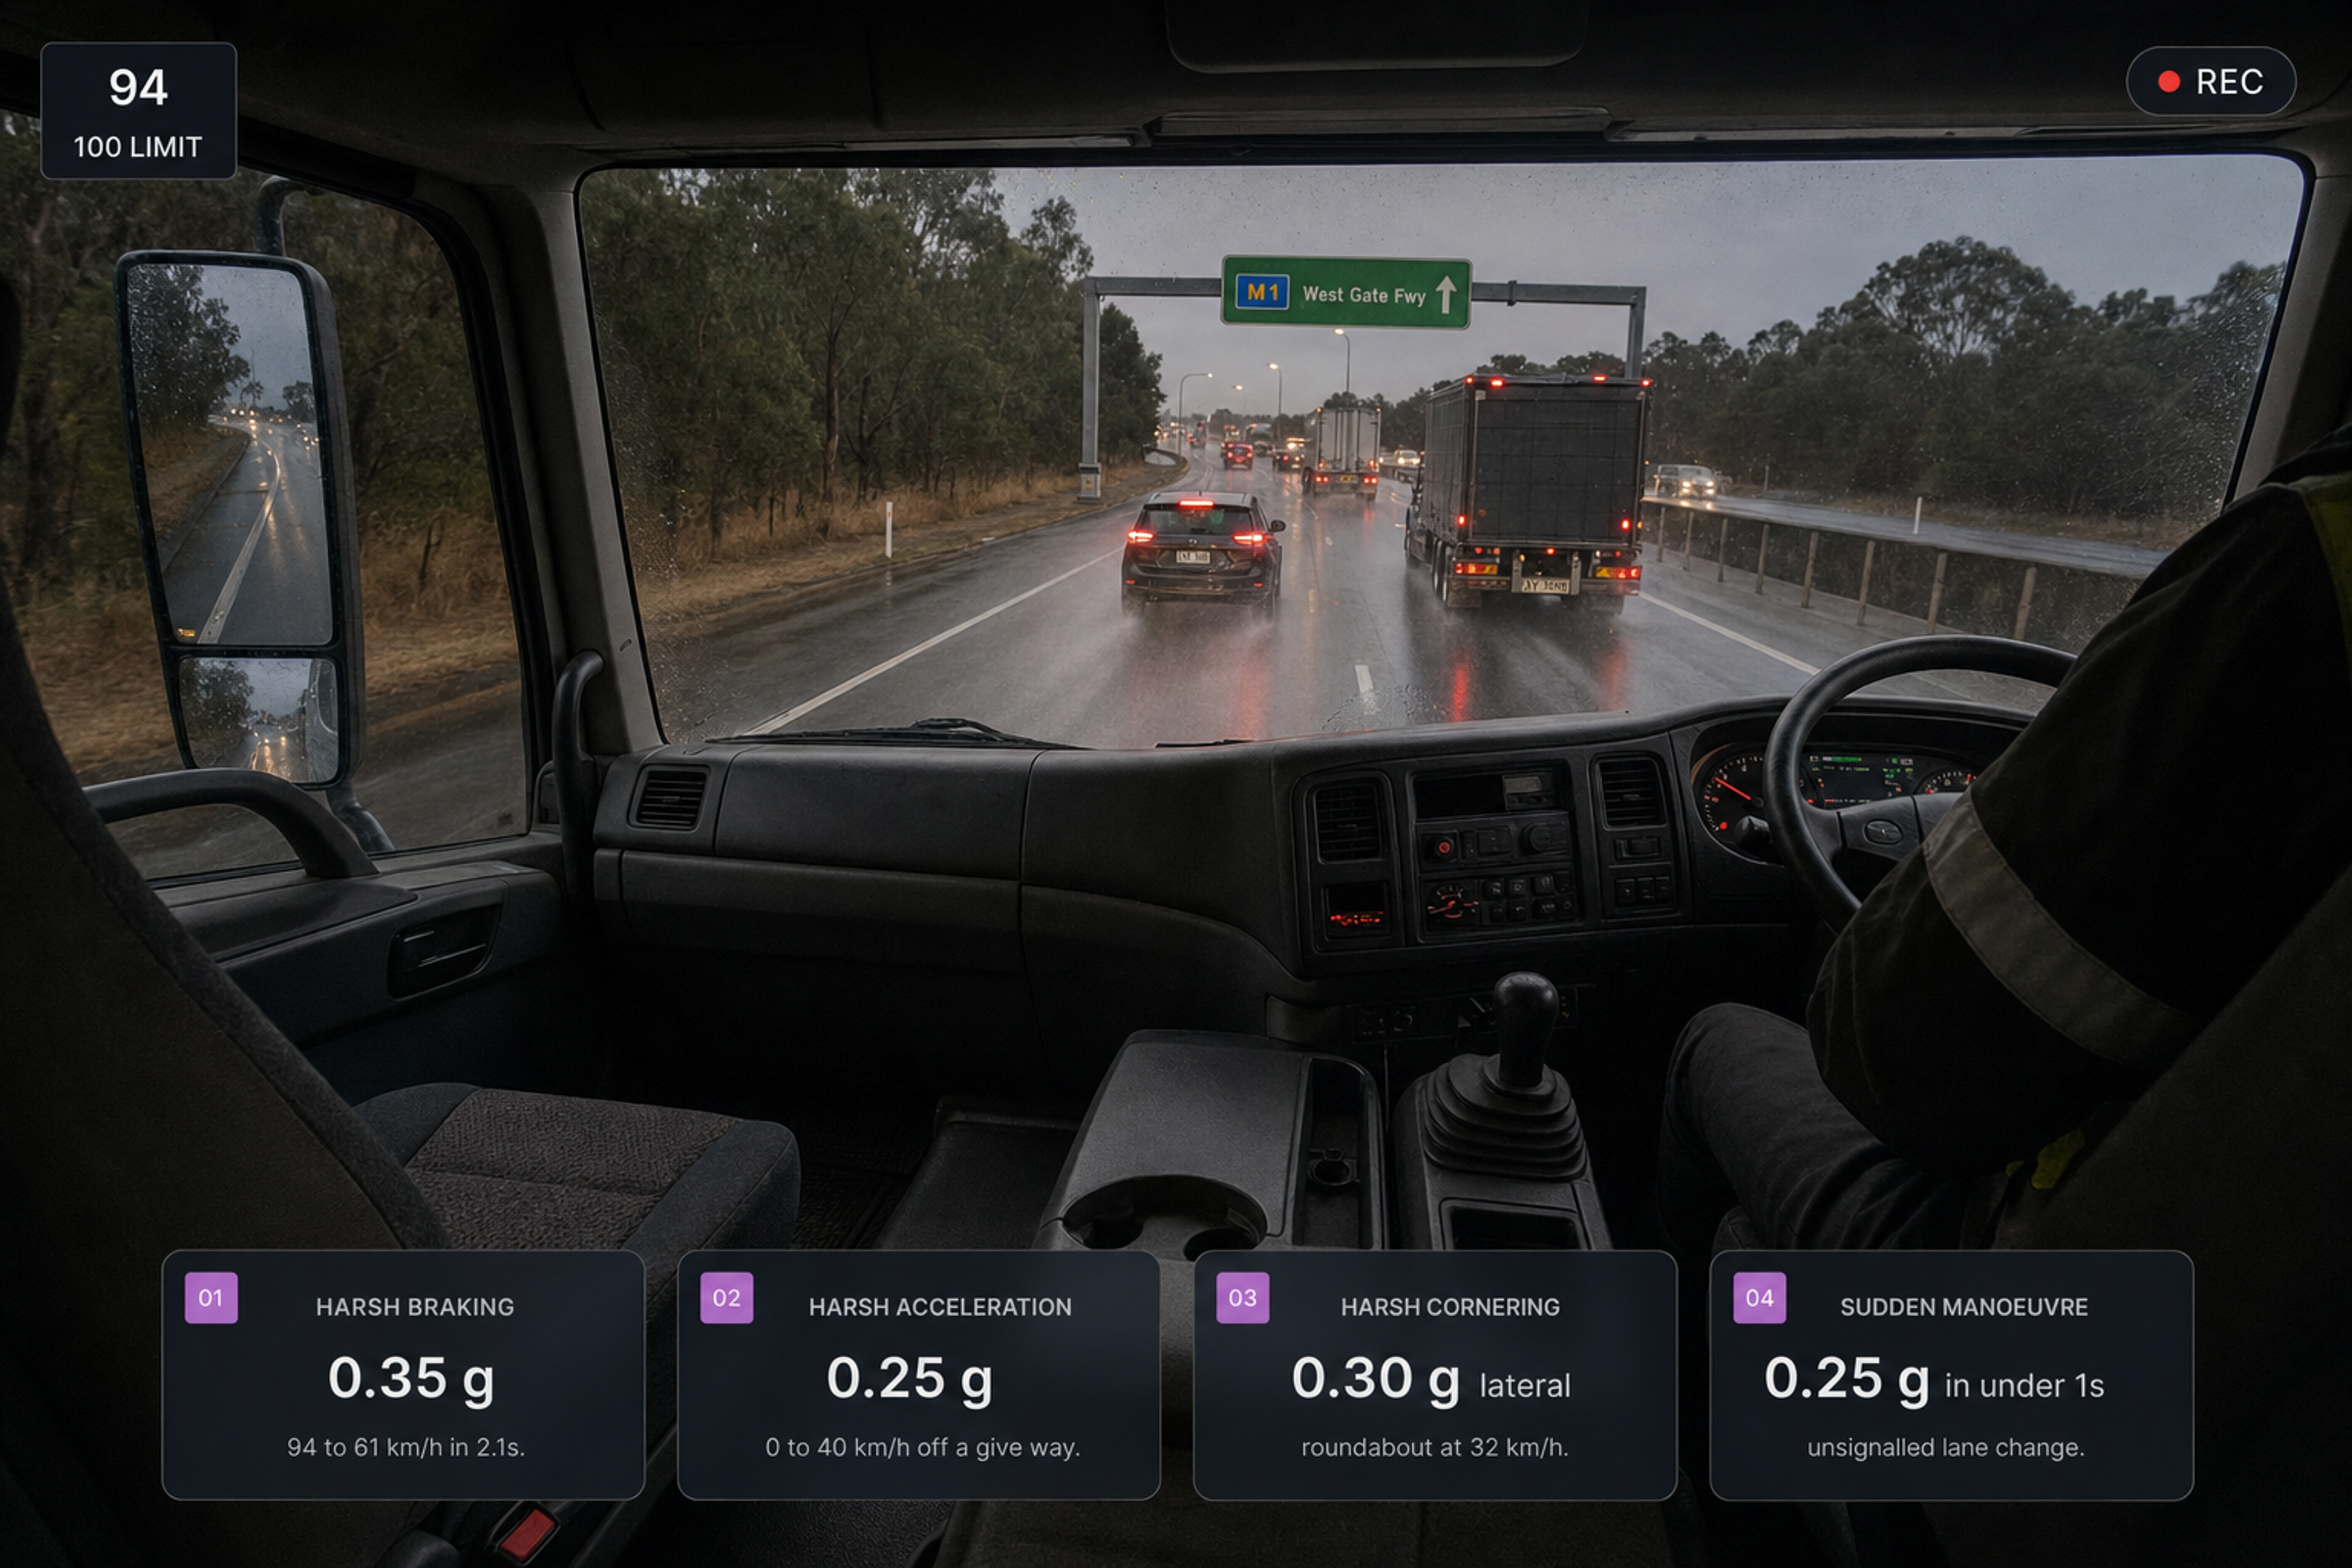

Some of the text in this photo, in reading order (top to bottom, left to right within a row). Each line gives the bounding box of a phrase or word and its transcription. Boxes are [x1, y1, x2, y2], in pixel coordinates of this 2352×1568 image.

[1248, 283, 1278, 301] M1
[1303, 285, 1427, 307] West Gate Fwy
